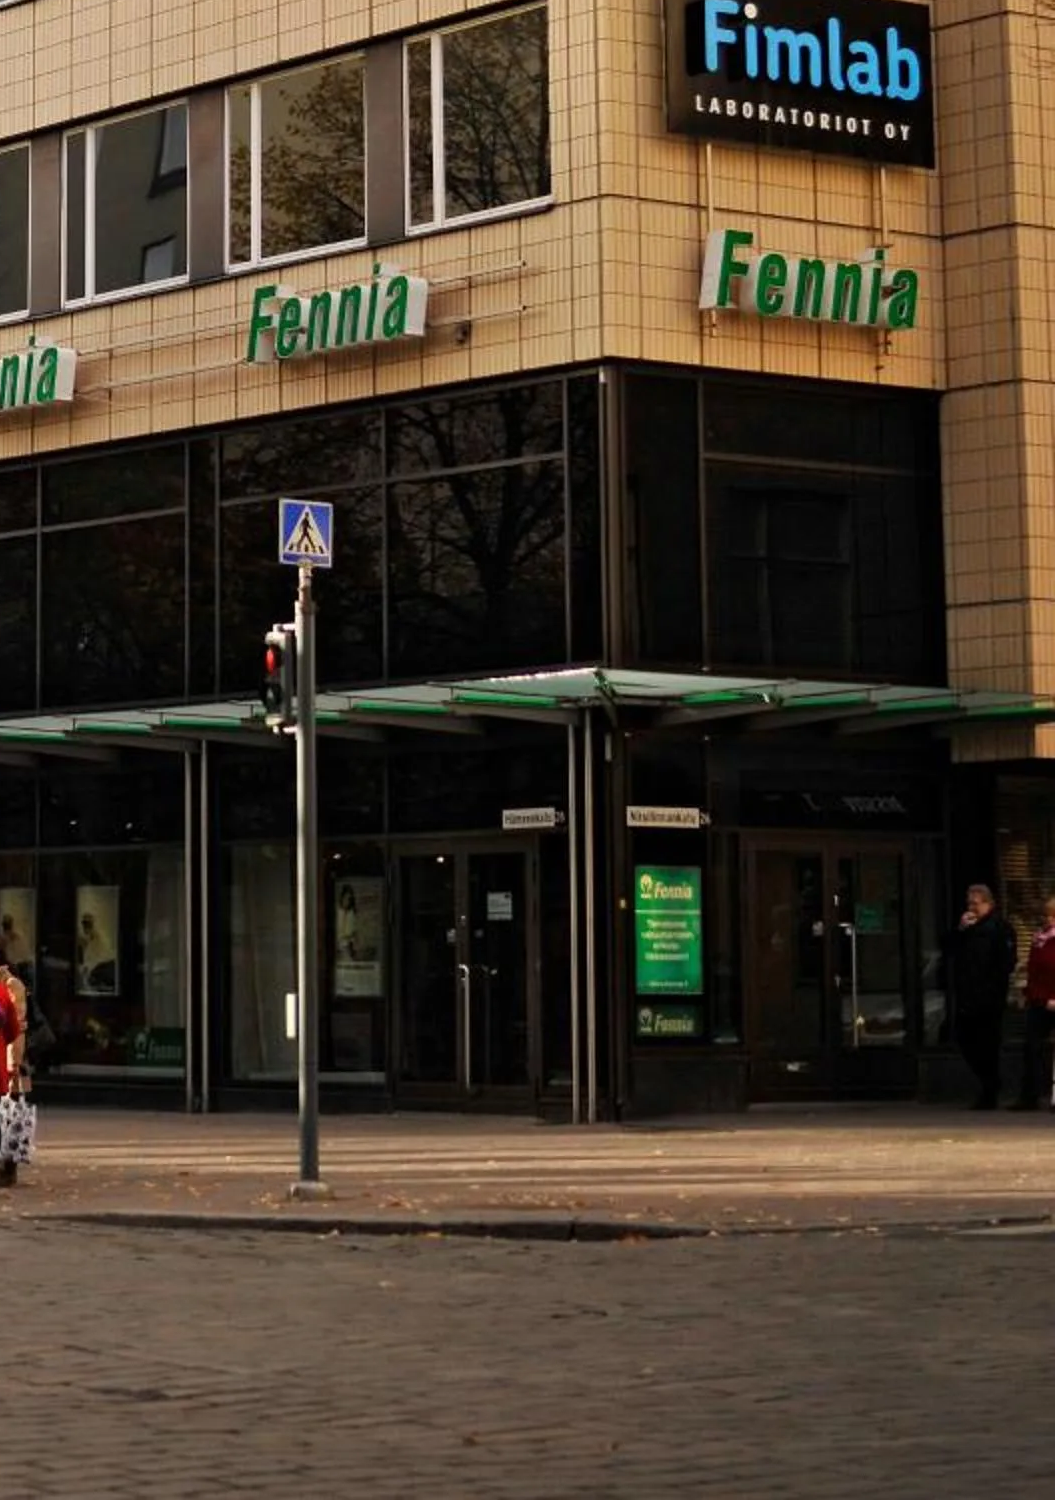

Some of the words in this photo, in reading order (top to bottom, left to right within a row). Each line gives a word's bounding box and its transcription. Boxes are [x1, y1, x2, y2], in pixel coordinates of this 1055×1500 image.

[695, 94, 873, 136] LABORATORIOT
[884, 121, 912, 142] OY
[246, 261, 410, 363] Fennia
[716, 229, 920, 330] Fennia
